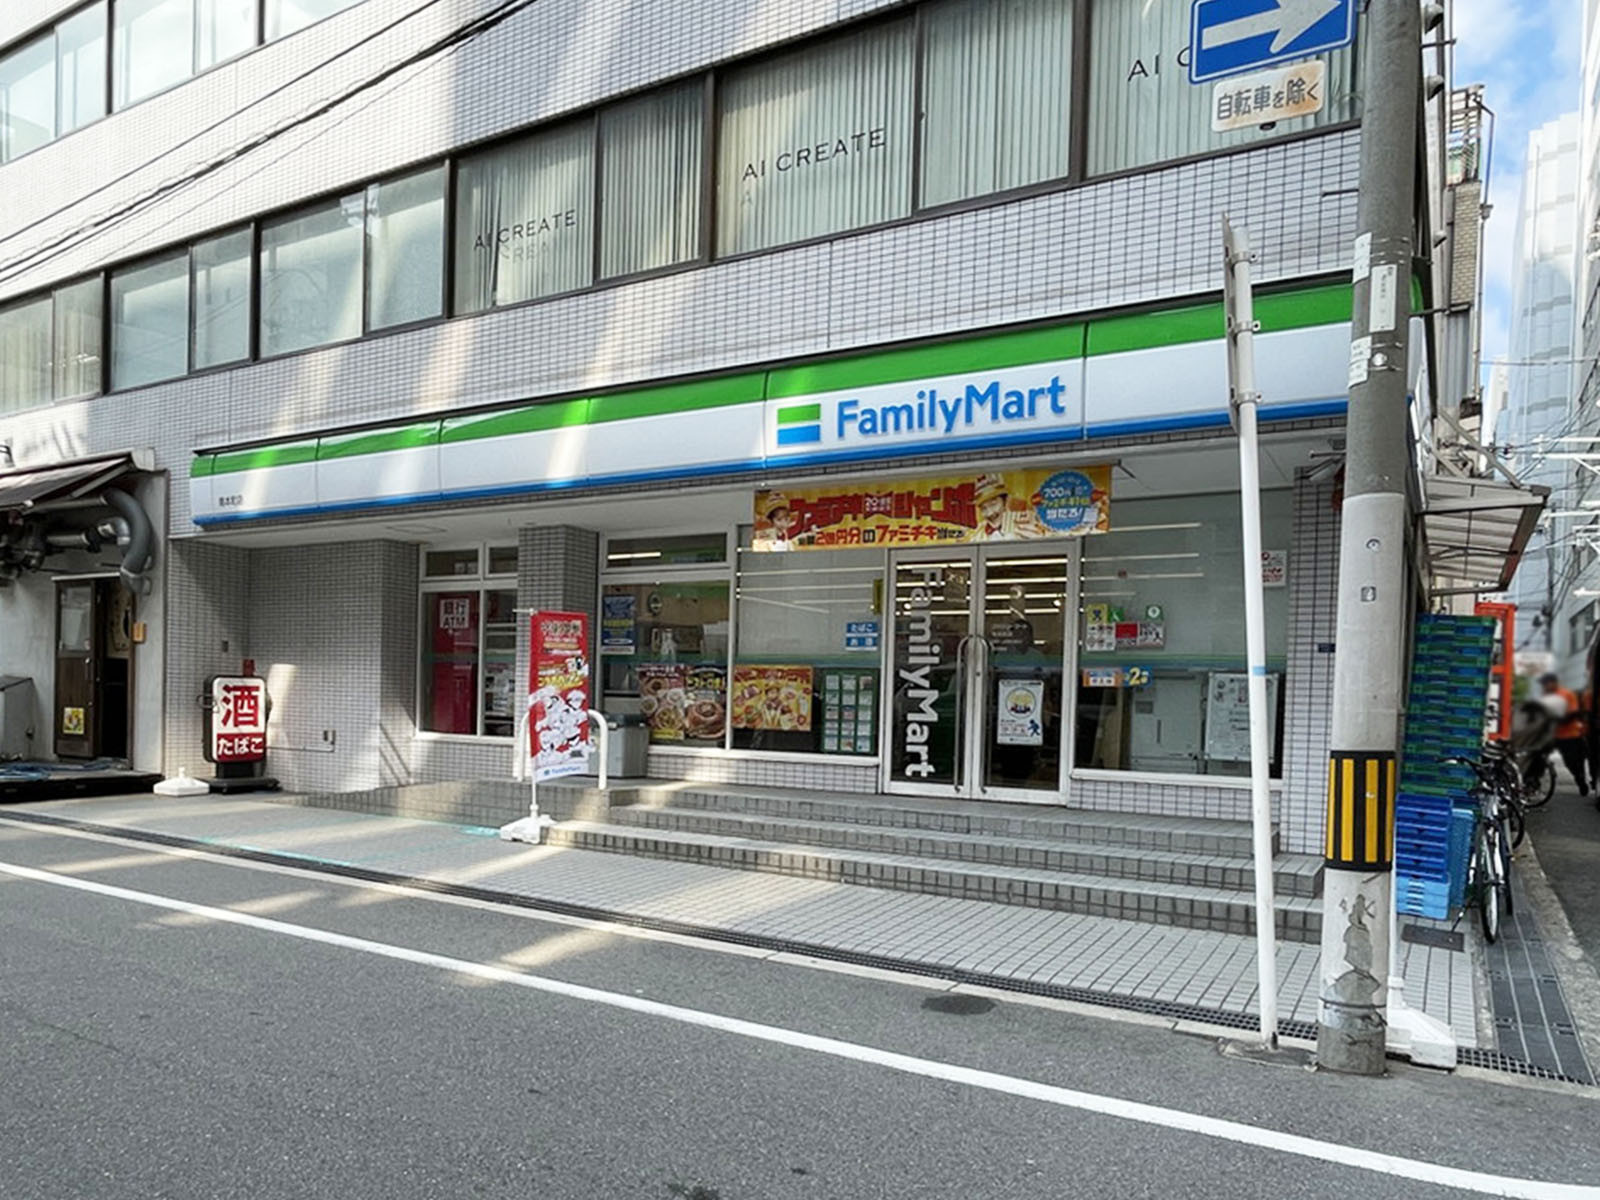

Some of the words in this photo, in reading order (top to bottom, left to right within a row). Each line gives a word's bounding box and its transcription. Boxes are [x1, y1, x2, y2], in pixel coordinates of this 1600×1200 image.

[1127, 54, 1160, 82] AI
[1217, 78, 1319, 120] 自転車を除く
[742, 159, 766, 182] AI
[776, 127, 886, 172] CREATE
[497, 208, 577, 244] CREATE
[837, 375, 1067, 440] FamilyMart
[900, 567, 943, 778] FamilyMart
[221, 684, 260, 728] 酒
[217, 737, 264, 756] たばこ
